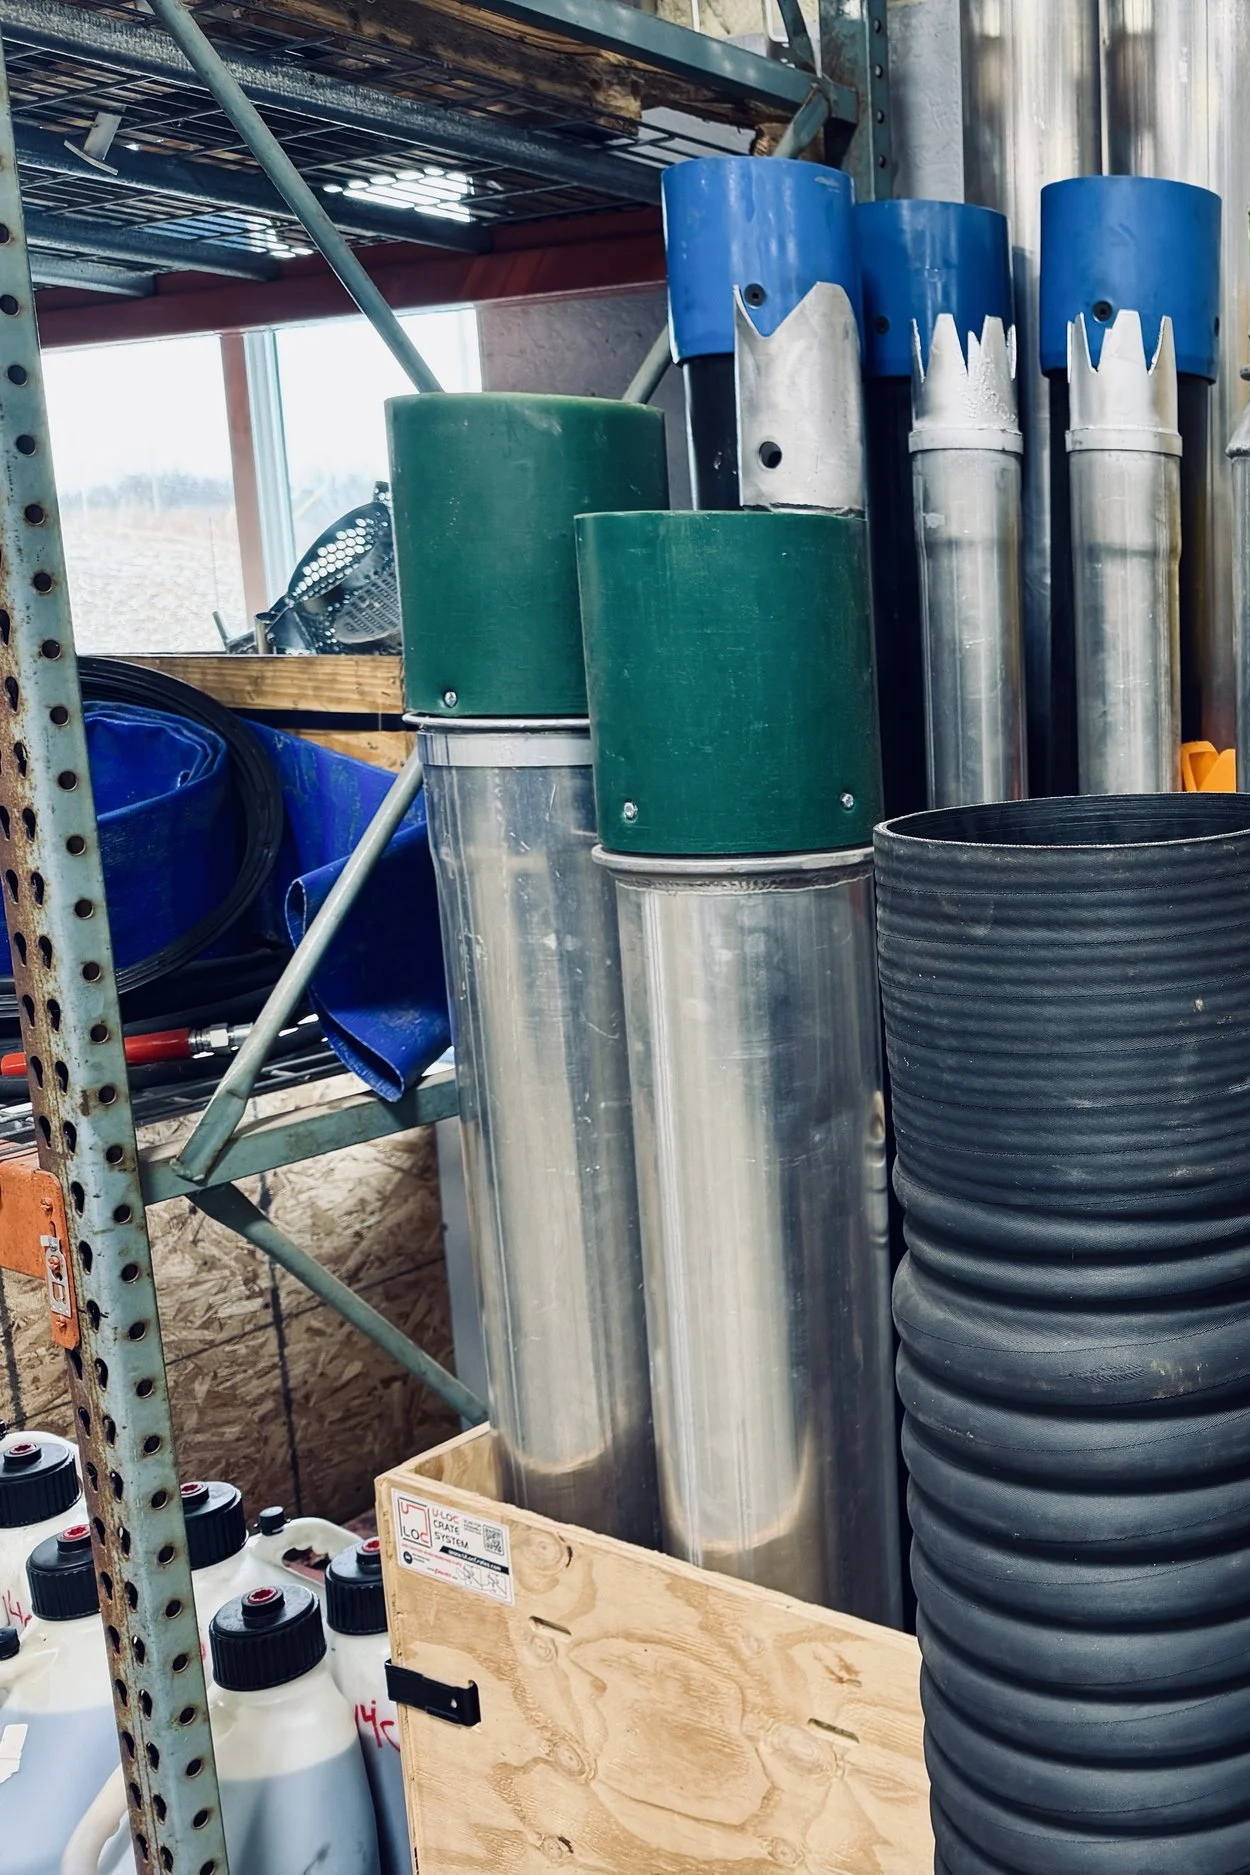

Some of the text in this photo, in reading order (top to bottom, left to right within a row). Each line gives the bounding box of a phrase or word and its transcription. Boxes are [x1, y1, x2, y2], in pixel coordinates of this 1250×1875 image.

[402, 1526, 429, 1544] LOC
[433, 1519, 460, 1536] CRATE
[434, 1532, 469, 1550] SYSTEM
